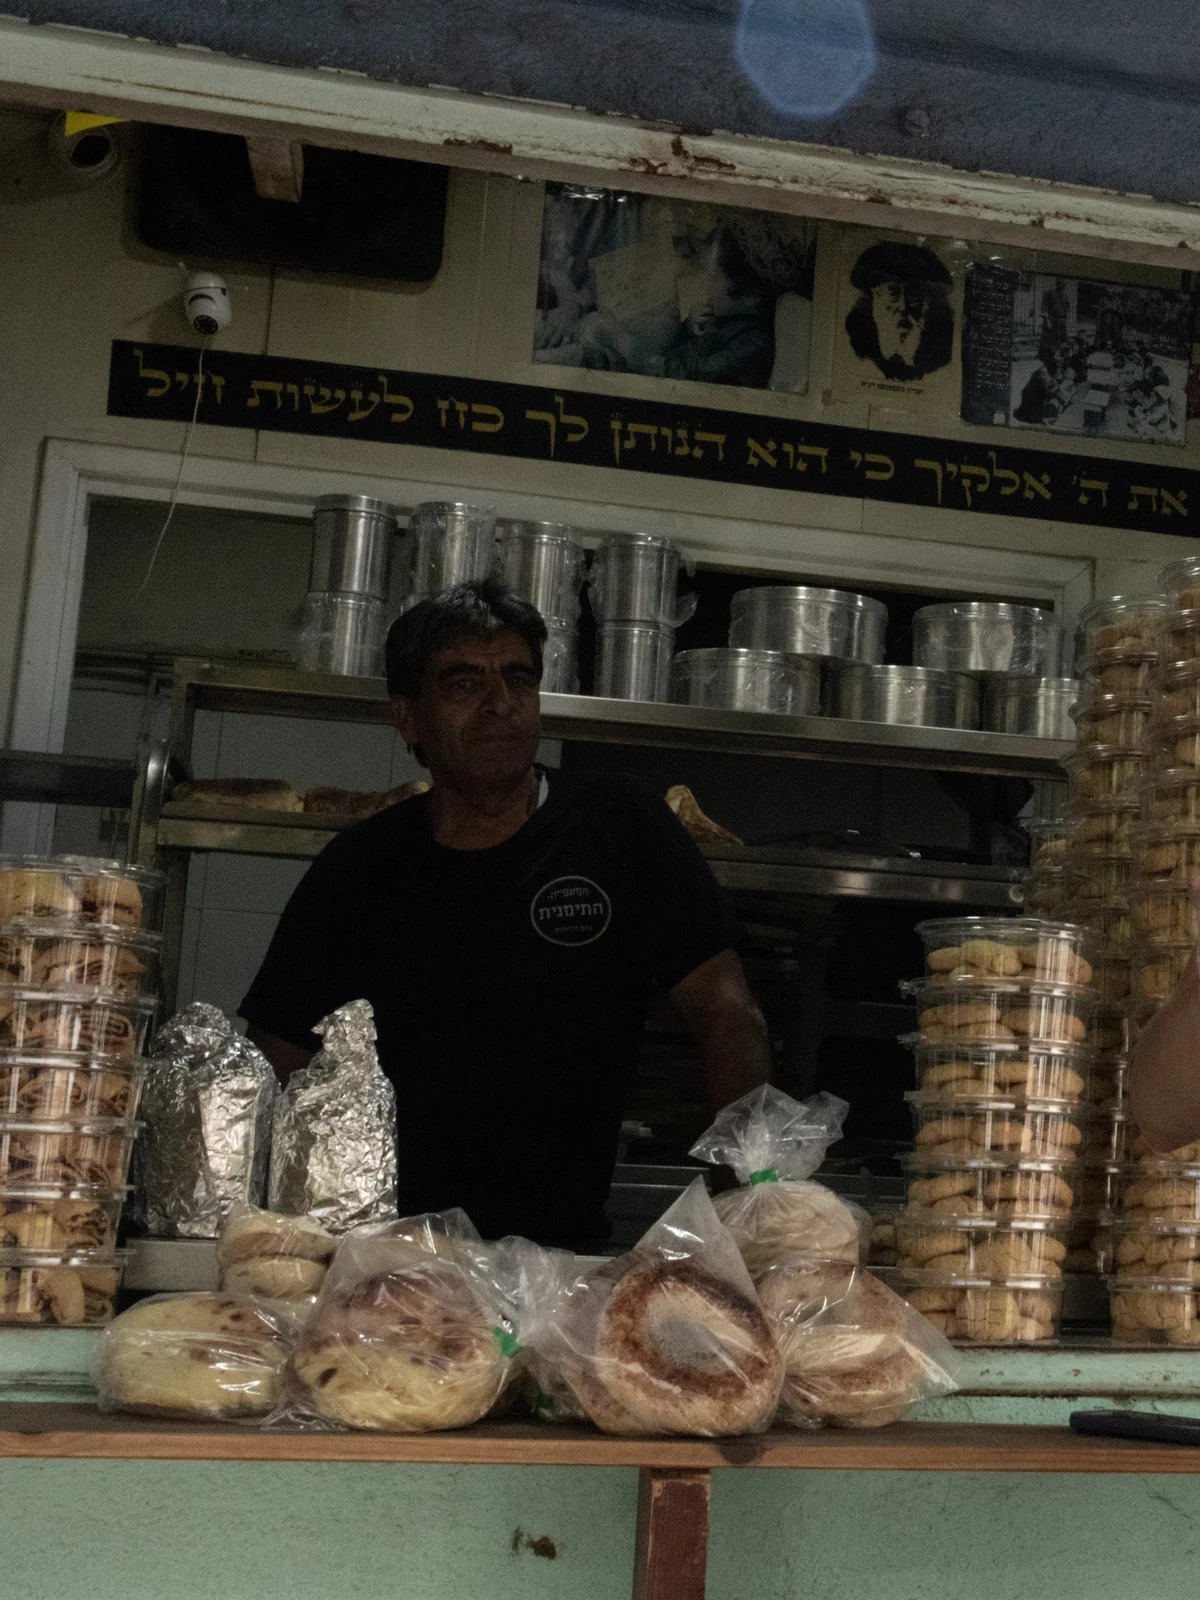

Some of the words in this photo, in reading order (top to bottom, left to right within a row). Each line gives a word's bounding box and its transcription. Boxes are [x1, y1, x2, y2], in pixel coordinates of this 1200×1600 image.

[246, 374, 414, 424] לעשות
[525, 393, 590, 458] לך
[610, 412, 727, 465] הנותן
[746, 434, 829, 474] הוא
[849, 448, 895, 481] כי
[914, 450, 1053, 508] אלקיך
[1128, 484, 1188, 518] את
[538, 903, 603, 920] התימנית
